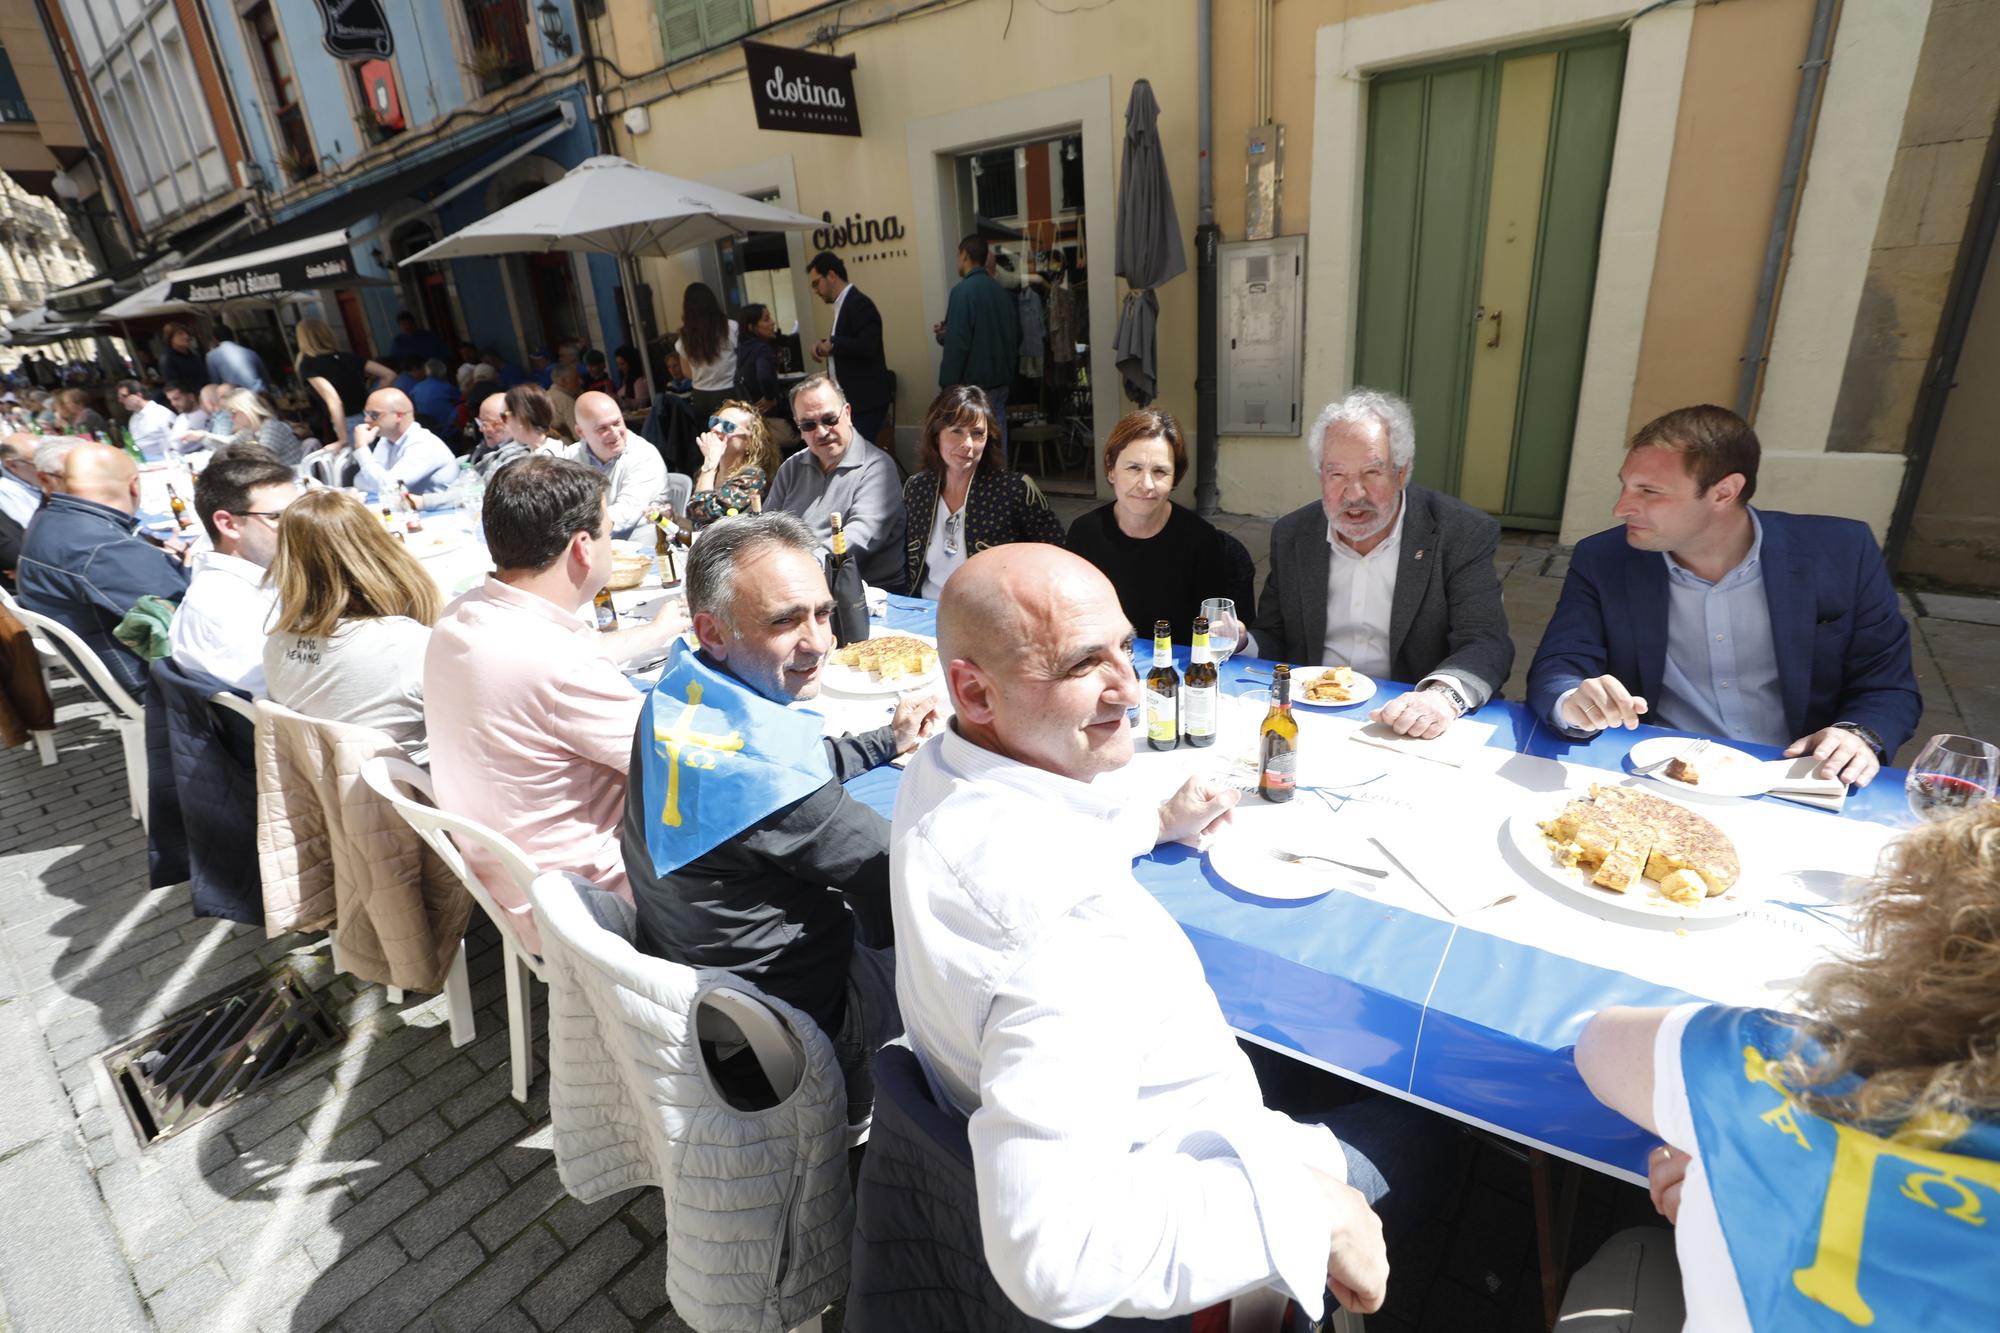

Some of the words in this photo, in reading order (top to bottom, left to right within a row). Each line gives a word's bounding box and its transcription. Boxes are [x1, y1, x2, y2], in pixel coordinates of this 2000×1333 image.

[765, 65, 846, 108] clotina
[769, 108, 797, 118] MODA
[803, 112, 848, 123] INFANTIL
[812, 210, 905, 251] clotina
[852, 249, 908, 263] INFANTIL
